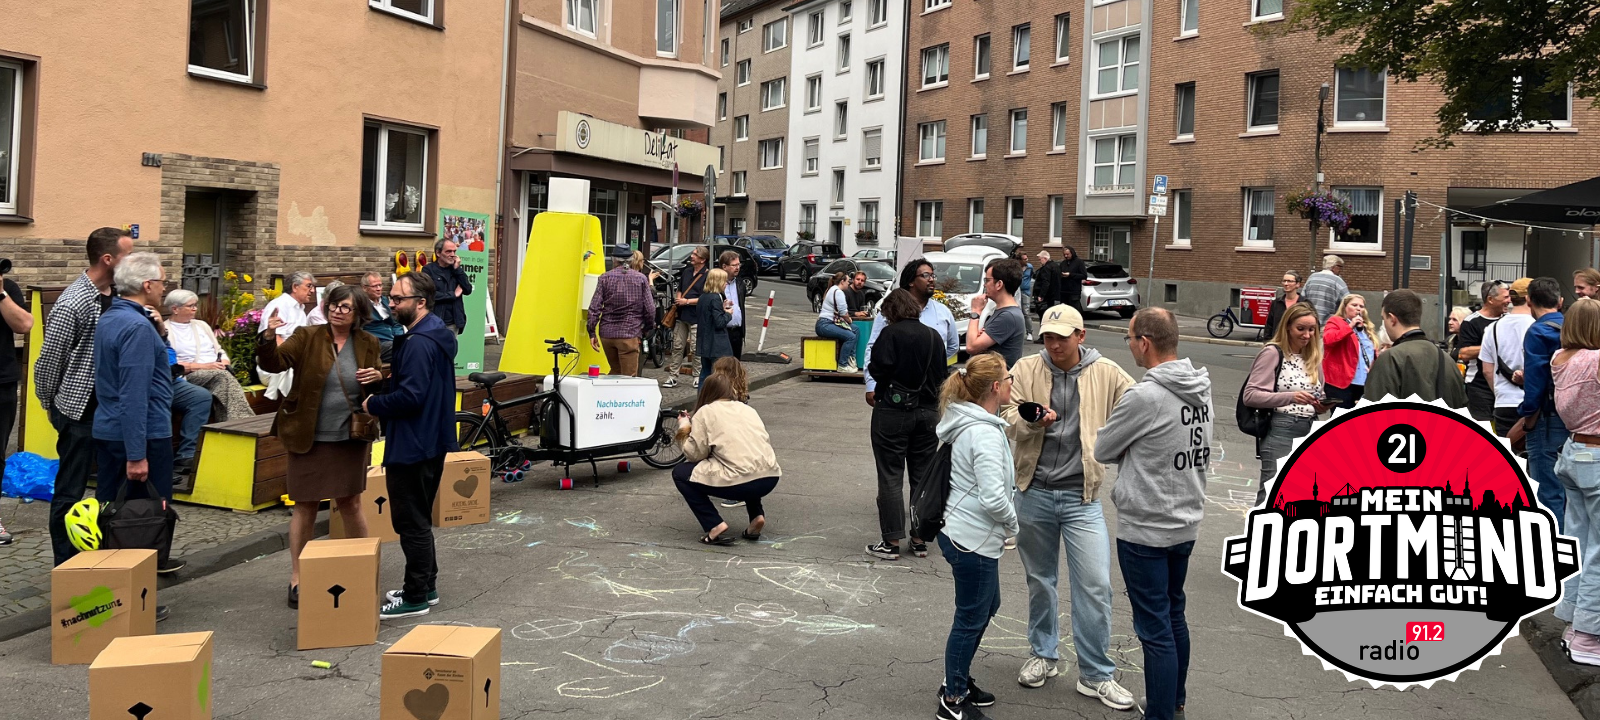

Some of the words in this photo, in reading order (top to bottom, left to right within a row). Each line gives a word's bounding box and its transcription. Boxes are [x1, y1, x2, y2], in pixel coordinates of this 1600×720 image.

[596, 399, 645, 408] Nachbarschaft
[595, 411, 615, 420] zählt.
[1181, 404, 1209, 426] CAR
[1189, 427, 1203, 447] IS
[1173, 447, 1210, 471] OVER
[61, 598, 123, 628] #nachnutzung
